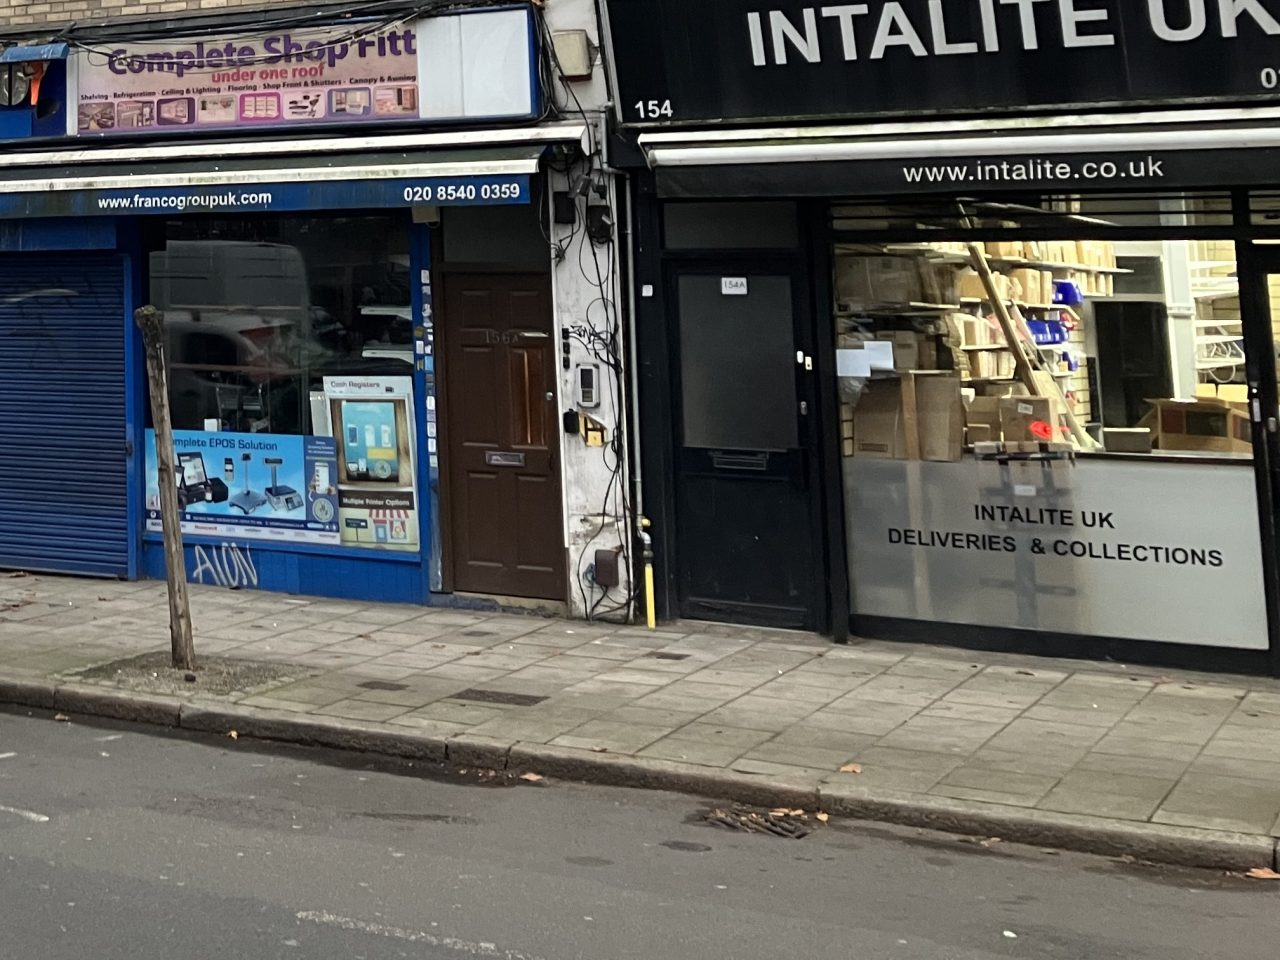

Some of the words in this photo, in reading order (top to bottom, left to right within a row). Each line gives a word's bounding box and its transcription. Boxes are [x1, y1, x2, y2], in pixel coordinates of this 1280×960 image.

[108, 41, 256, 77] Complete
[264, 33, 349, 68] Shop
[211, 69, 257, 84] under
[258, 67, 289, 80] one
[291, 64, 325, 78] roof
[262, 82, 281, 90] Shop
[349, 76, 378, 85] Canopy
[634, 100, 674, 119] 154
[902, 156, 1165, 185] www.intalite.co.uk
[98, 191, 272, 209] www.francogroupuk.com
[403, 187, 432, 202] 020
[436, 185, 476, 200] 8540
[480, 183, 521, 199] 0359
[208, 437, 236, 449] EPOS
[237, 439, 278, 451] Solution
[973, 504, 1074, 528] INTALITE
[1080, 508, 1116, 530] UK
[887, 527, 1017, 554] DELIVERIES
[1030, 538, 1046, 555] &
[1053, 539, 1224, 567] COLLECTIONS
